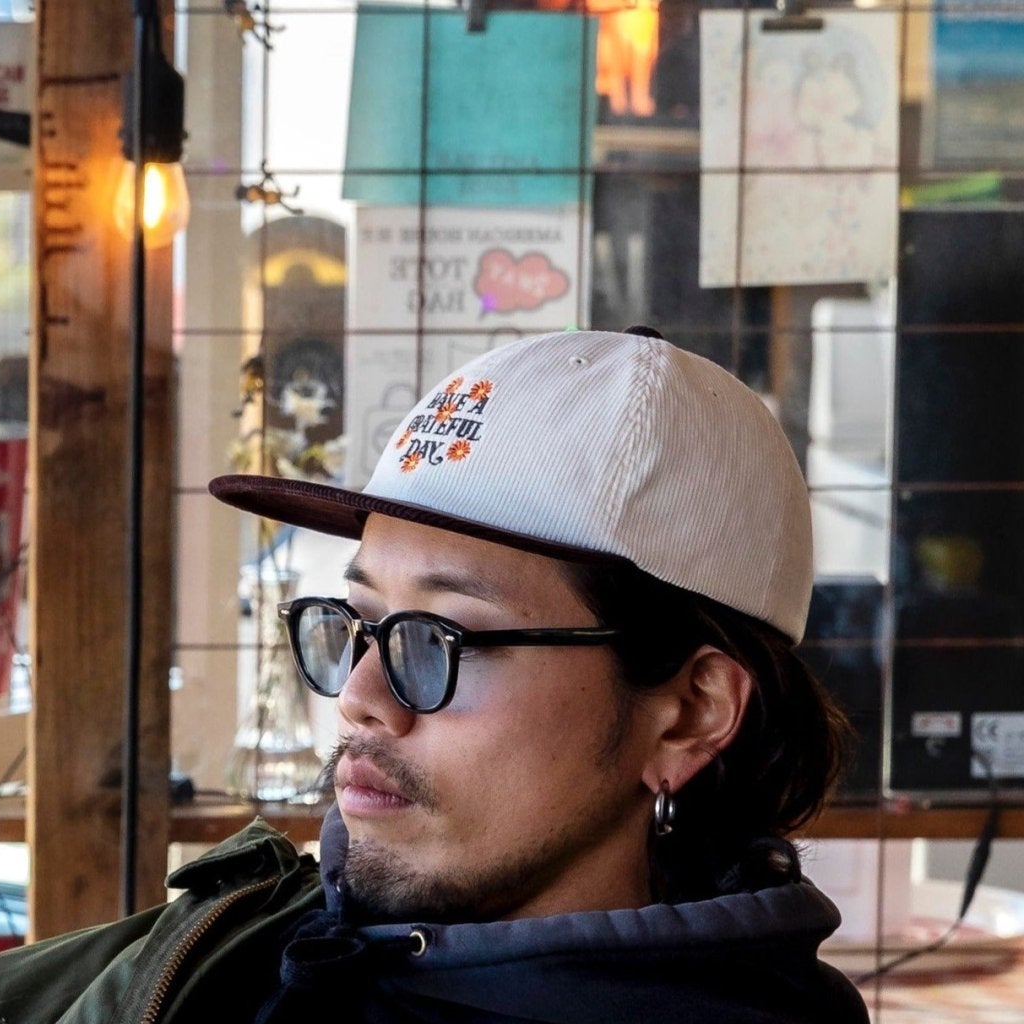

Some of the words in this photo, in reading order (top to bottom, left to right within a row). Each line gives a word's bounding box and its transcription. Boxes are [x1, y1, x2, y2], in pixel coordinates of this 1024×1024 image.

[426, 391, 470, 412] HAVE
[467, 394, 489, 415] A
[406, 413, 484, 442] GRATEFUL
[399, 438, 445, 466] DAY
